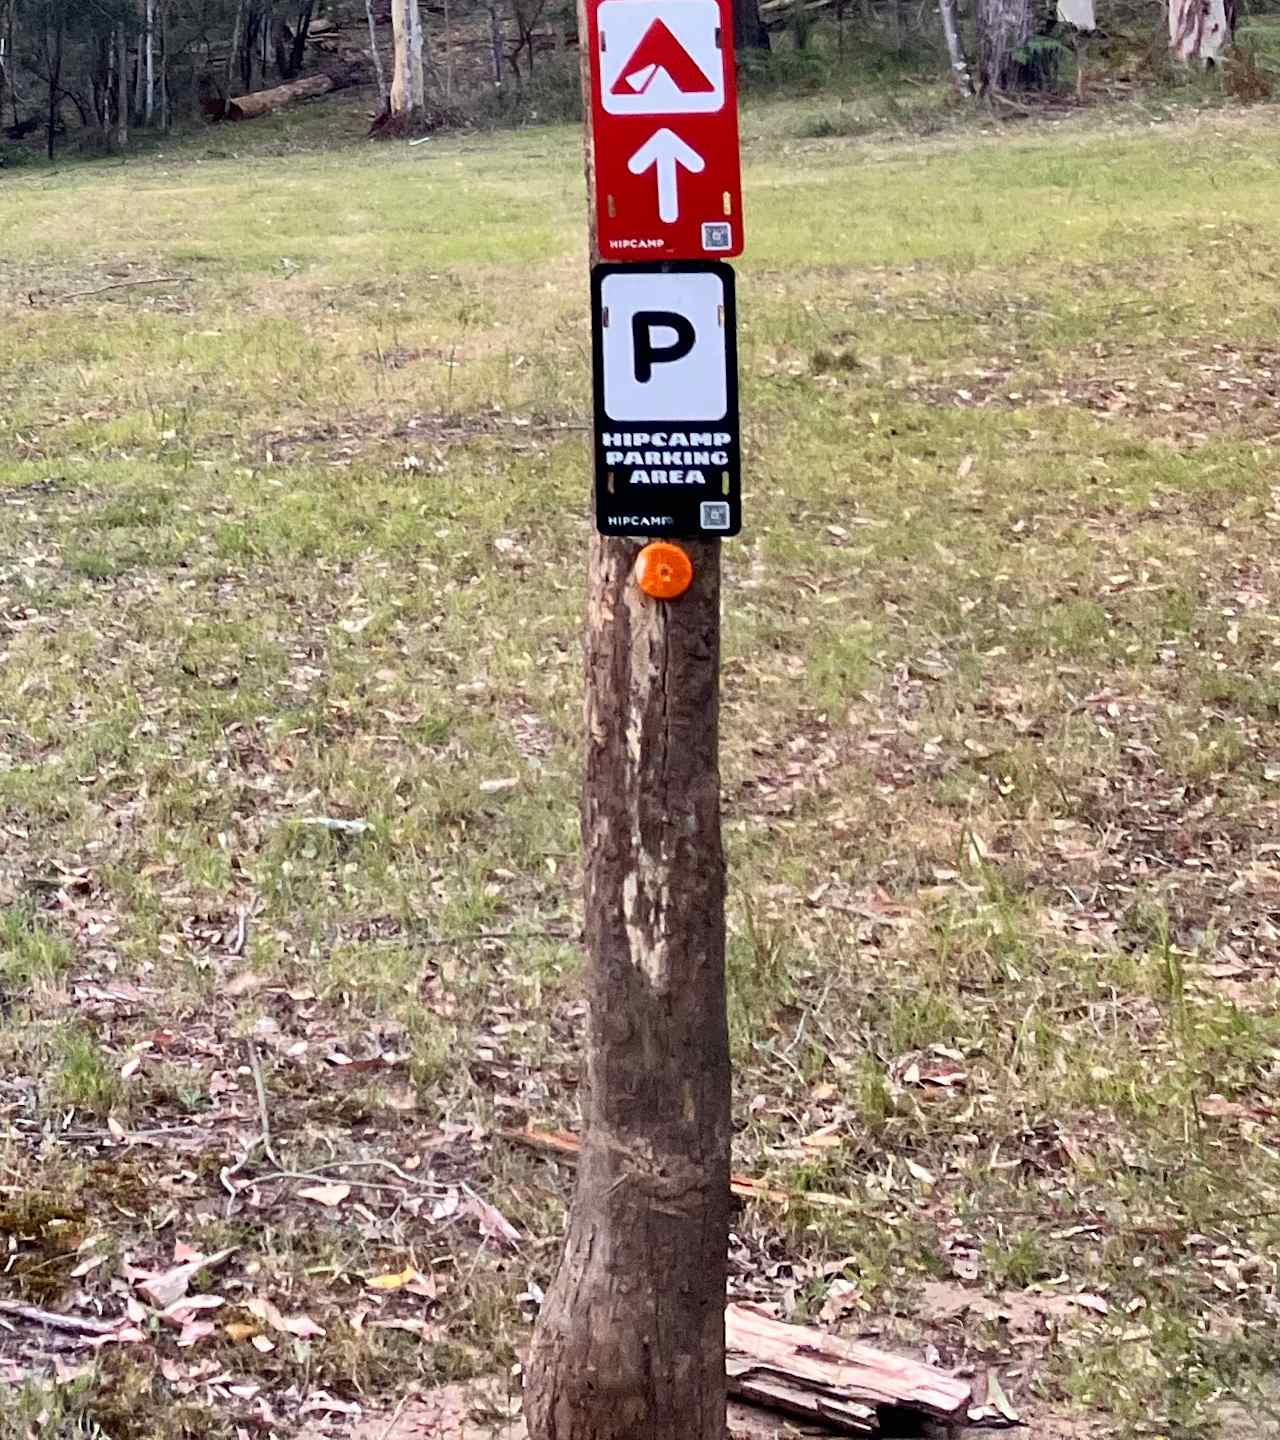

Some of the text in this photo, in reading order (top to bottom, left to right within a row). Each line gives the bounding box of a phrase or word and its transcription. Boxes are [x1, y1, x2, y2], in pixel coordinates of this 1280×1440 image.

[609, 239, 665, 249] HIPCAMP
[632, 311, 696, 383] P
[602, 432, 731, 447] HIPCAMP
[606, 451, 729, 465] PARKING
[629, 470, 706, 484] AREA
